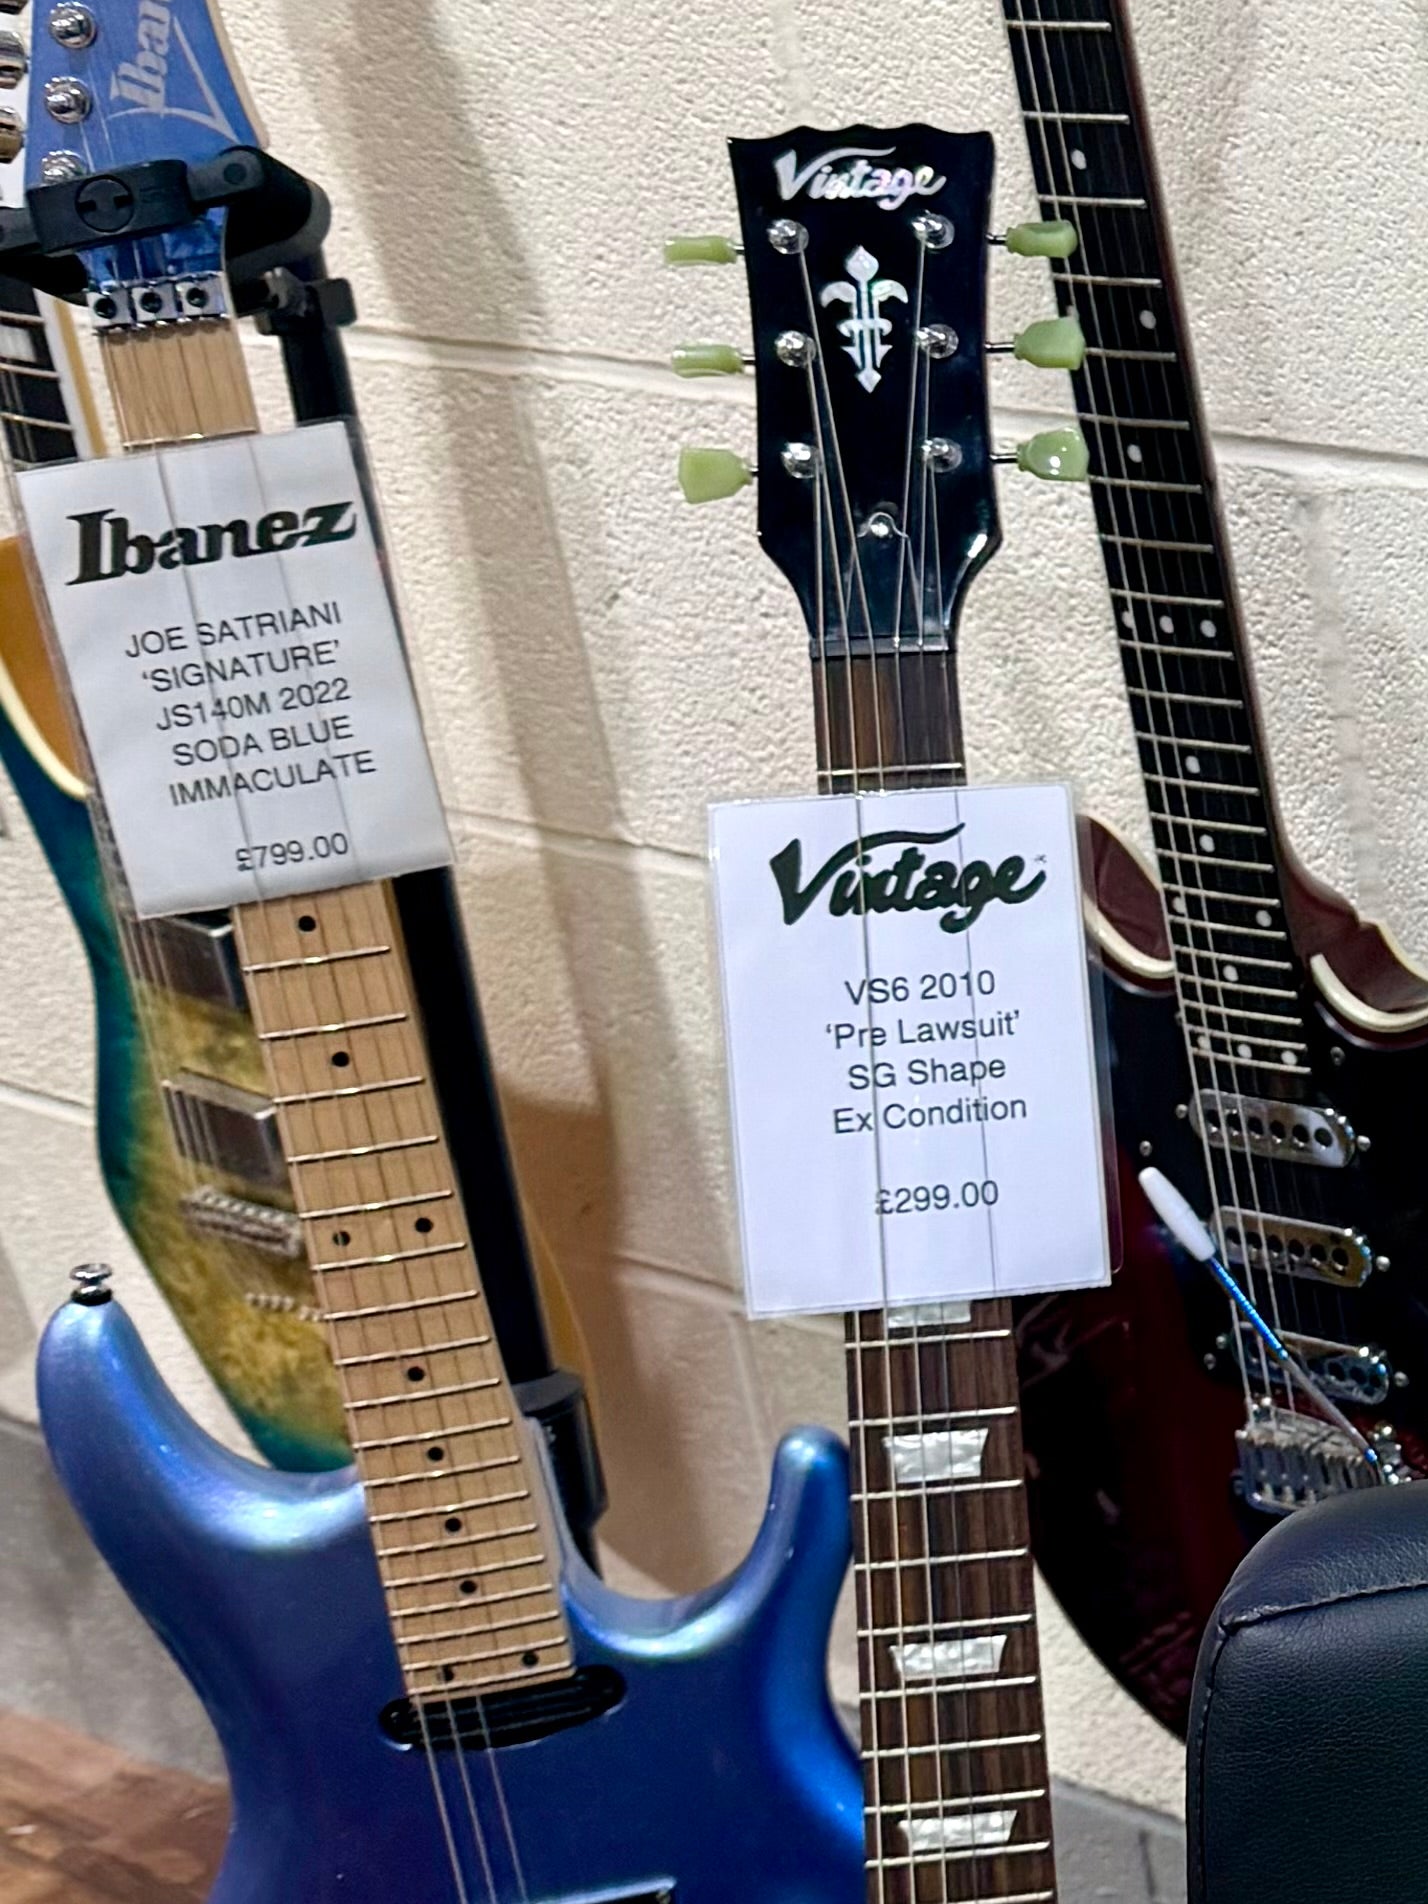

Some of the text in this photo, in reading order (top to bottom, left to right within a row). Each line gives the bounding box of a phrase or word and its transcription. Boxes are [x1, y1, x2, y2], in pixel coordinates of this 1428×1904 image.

[773, 146, 947, 211] Vintage
[65, 501, 357, 586] Ibanez
[125, 601, 342, 658] JOE SATRIANI
[156, 677, 352, 731] JS140M 2022
[172, 715, 355, 766] SODA BLUE
[169, 750, 378, 806] IMMACULATE
[236, 832, 349, 872] £799.00
[769, 822, 1047, 934] Vintage
[844, 970, 996, 1006] VS6 2010
[848, 1057, 1007, 1090] SG Shape
[833, 1096, 1027, 1134] Ex Condition
[875, 1180, 1000, 1215] £299.00
